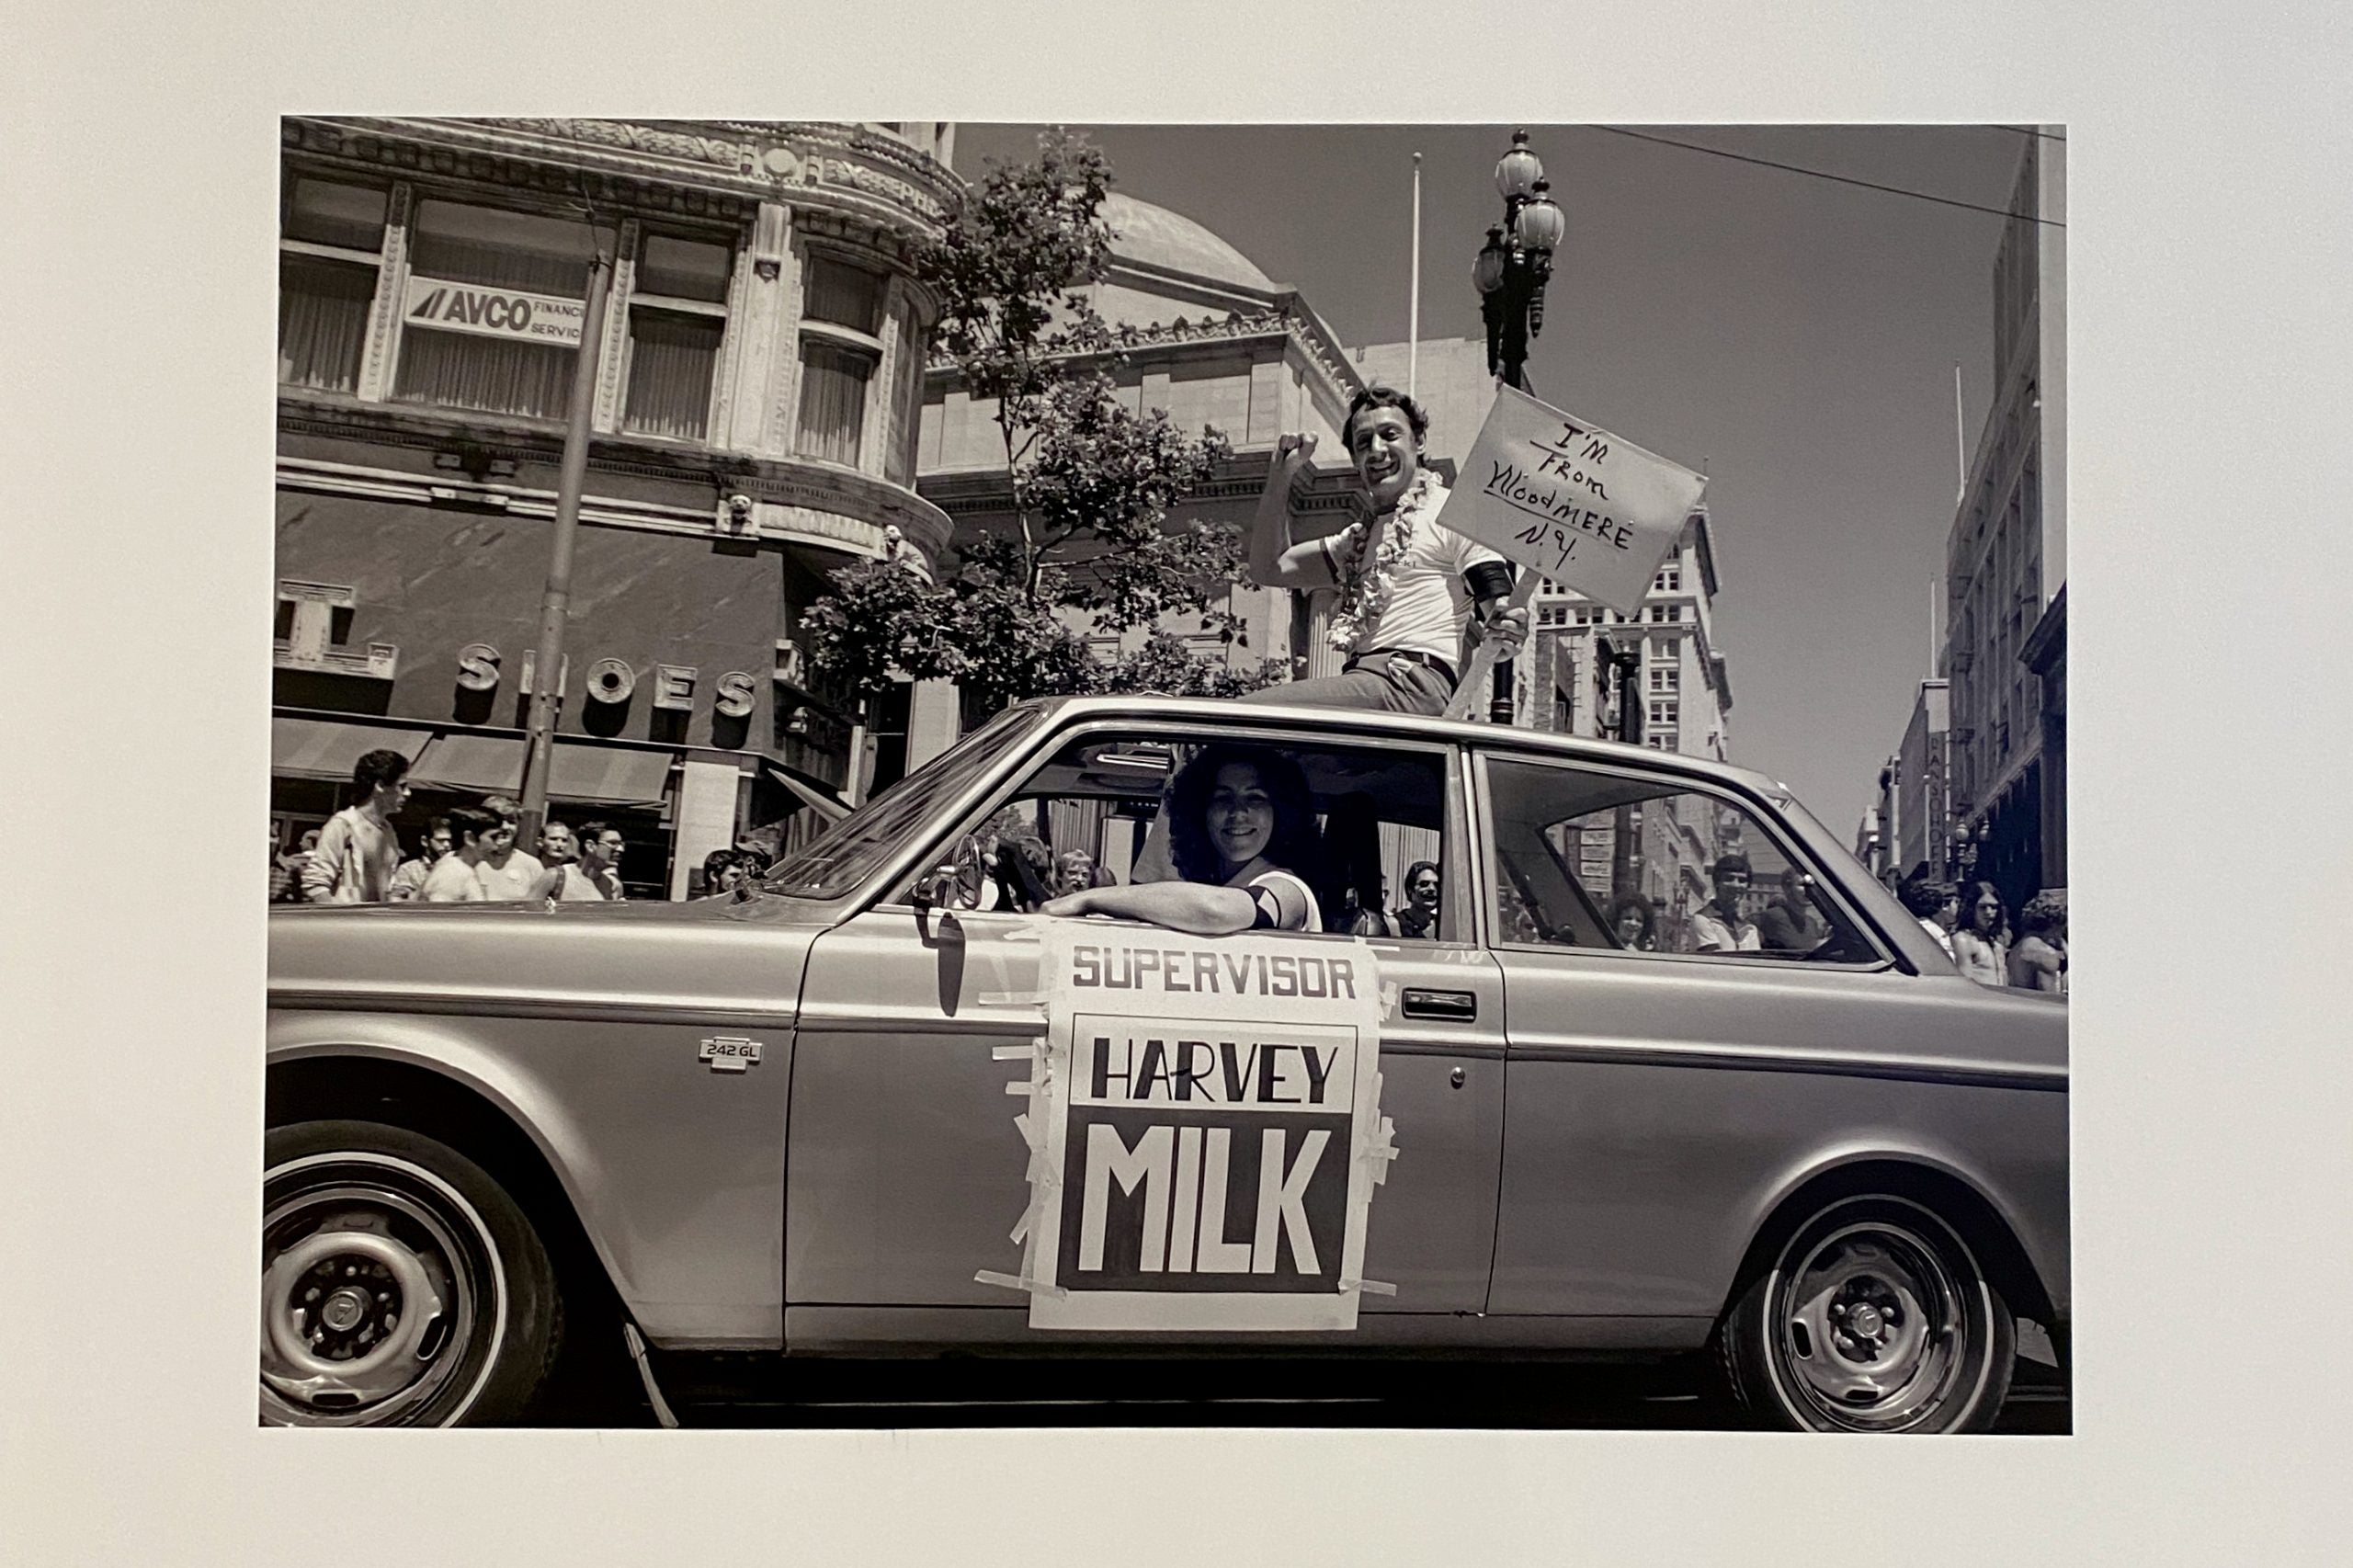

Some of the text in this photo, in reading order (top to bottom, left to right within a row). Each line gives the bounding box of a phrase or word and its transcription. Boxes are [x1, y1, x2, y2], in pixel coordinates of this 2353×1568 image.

[443, 290, 531, 331] AVCO
[1073, 946, 1356, 1000] SUPERVISOR
[707, 1044, 757, 1058] 242 GL
[1091, 1037, 1339, 1104] HARVEY
[1078, 1123, 1332, 1276] MILK
